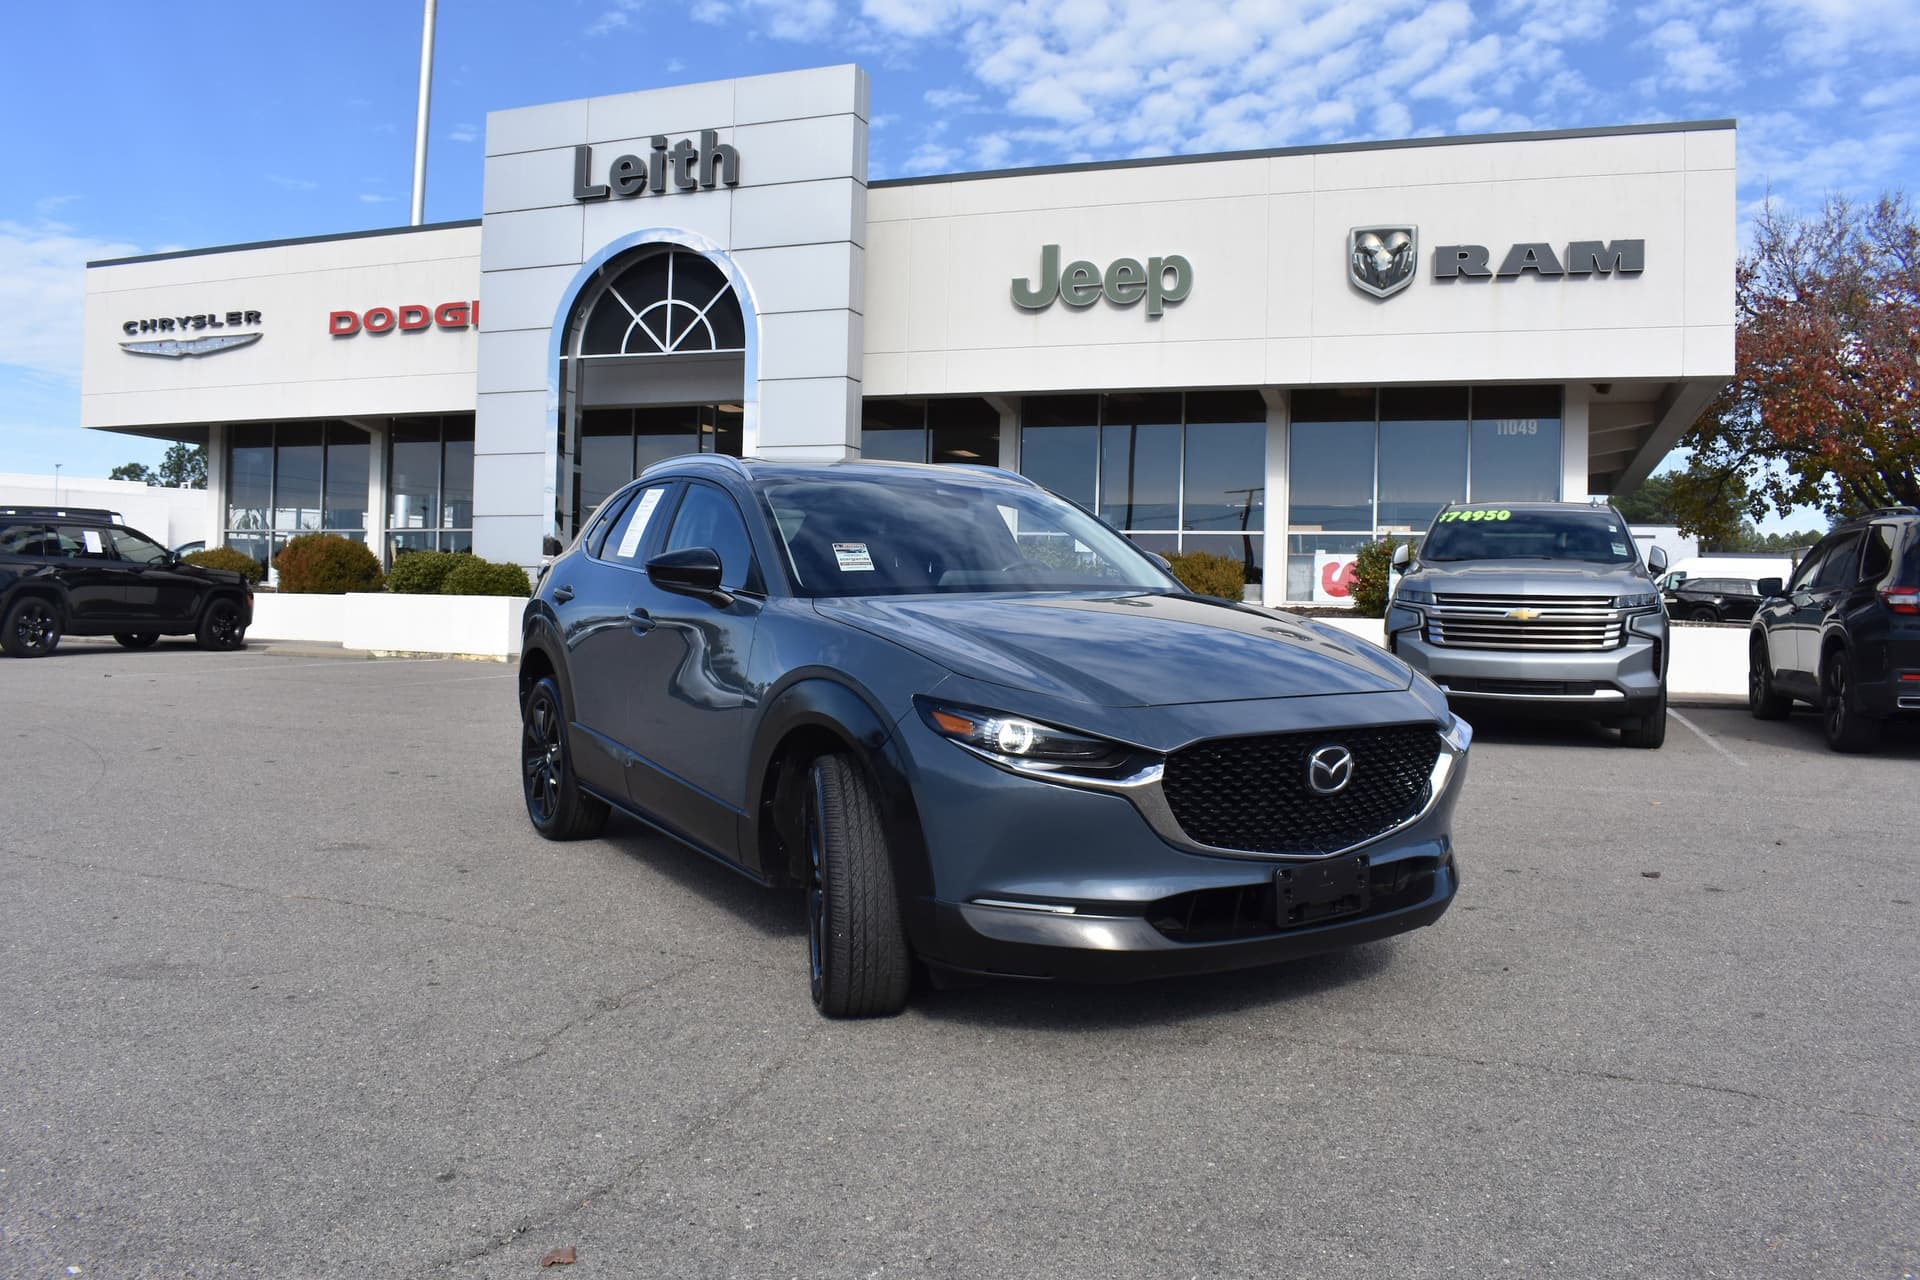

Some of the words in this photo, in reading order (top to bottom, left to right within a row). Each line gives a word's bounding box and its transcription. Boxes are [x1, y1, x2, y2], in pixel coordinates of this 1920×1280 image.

[574, 129, 740, 200] Leith
[1433, 239, 1646, 279] RAM
[1011, 244, 1195, 318] Jeep
[122, 310, 262, 335] CHRYSLER
[1496, 420, 1537, 435] 11049
[1439, 510, 1511, 523] $74950
